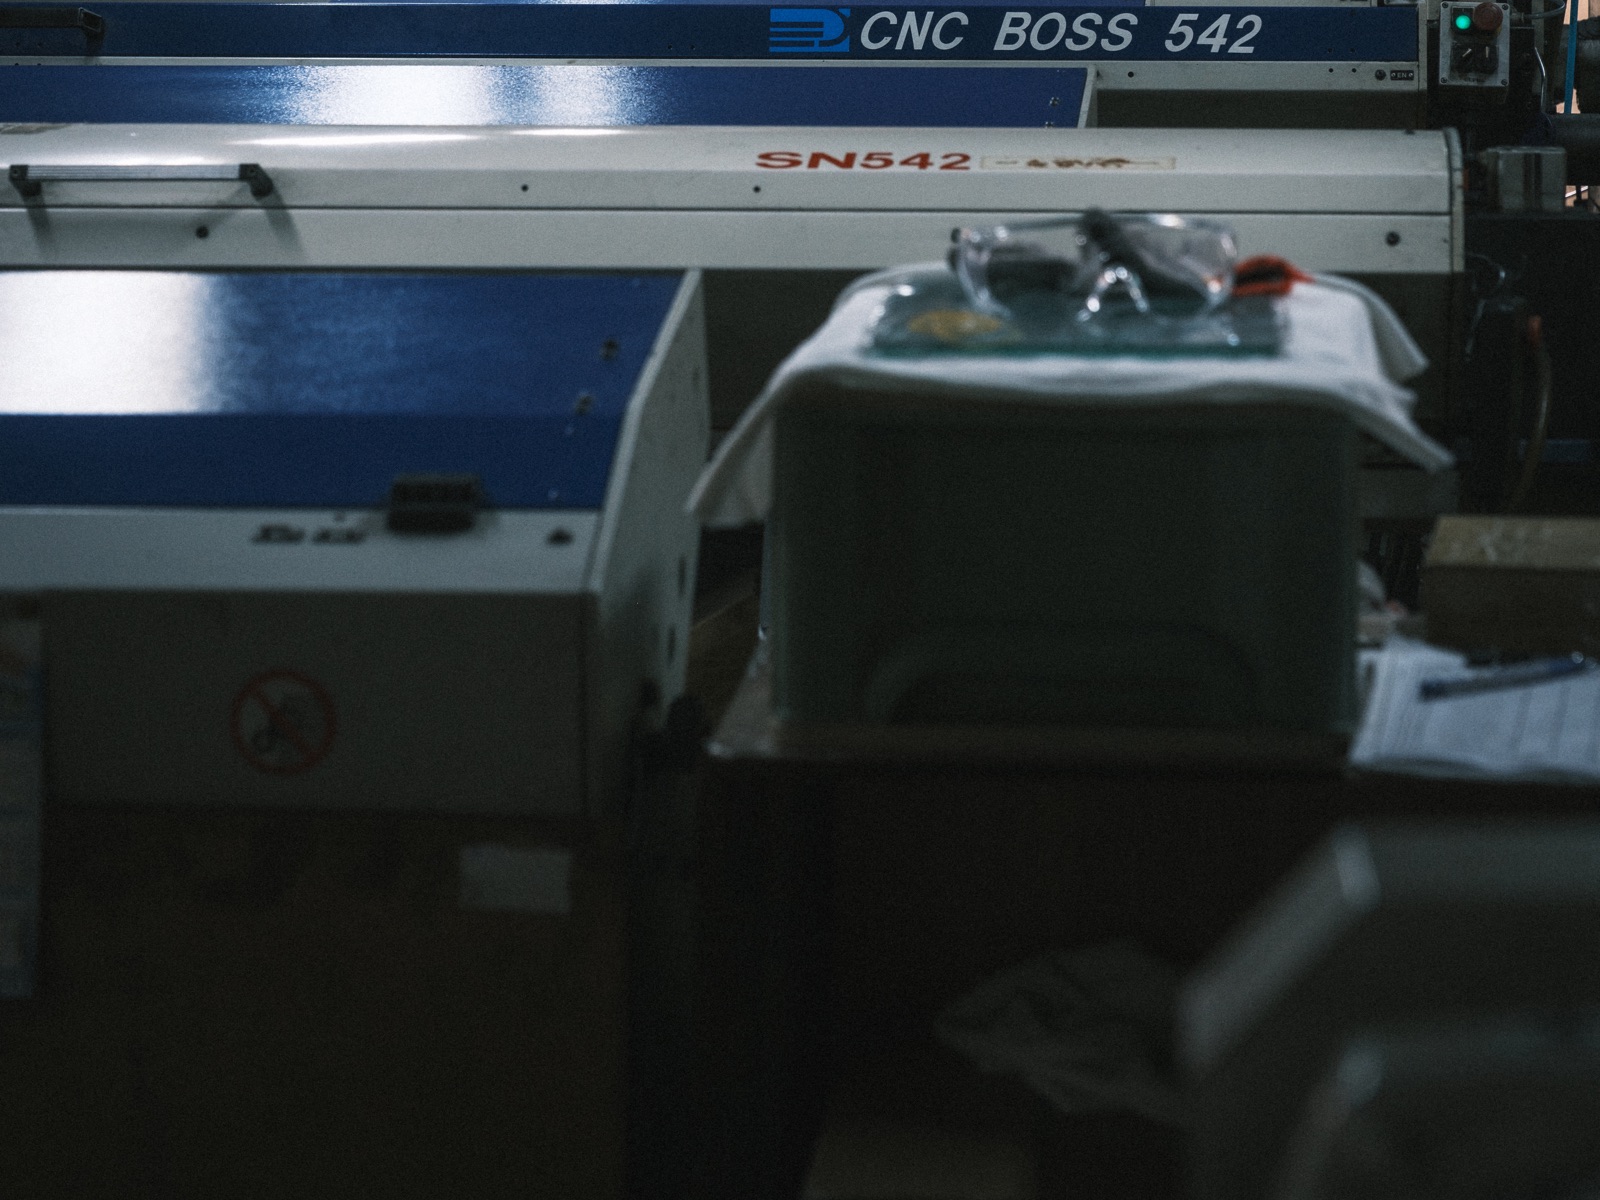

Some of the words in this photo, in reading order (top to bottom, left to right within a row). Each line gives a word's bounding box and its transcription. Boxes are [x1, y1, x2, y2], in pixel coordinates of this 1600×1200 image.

[859, 10, 969, 51] CNC
[993, 11, 1138, 52] BOSS
[1164, 13, 1263, 54] 542
[755, 151, 972, 171] SN542
